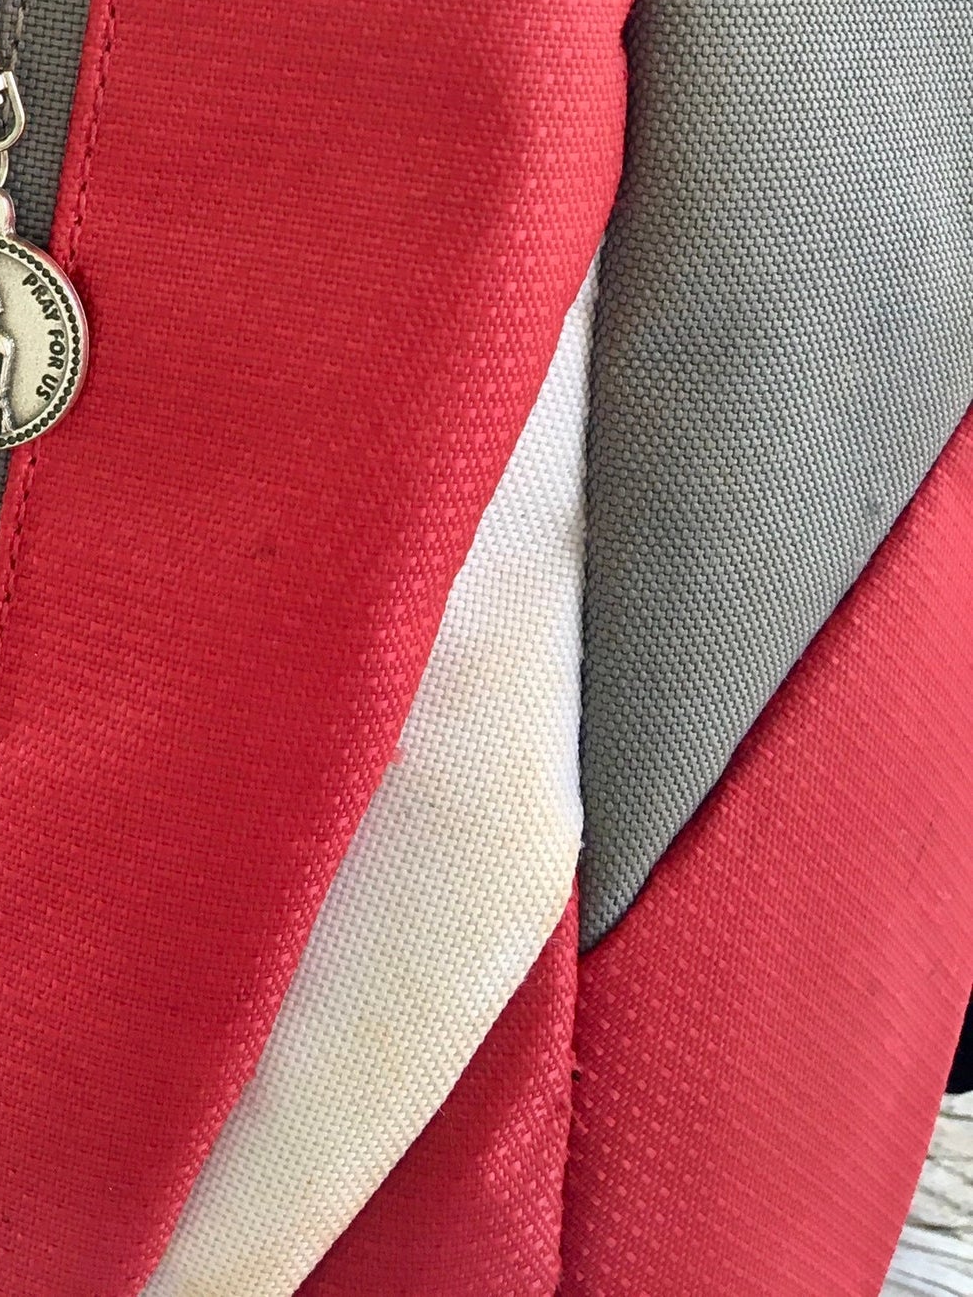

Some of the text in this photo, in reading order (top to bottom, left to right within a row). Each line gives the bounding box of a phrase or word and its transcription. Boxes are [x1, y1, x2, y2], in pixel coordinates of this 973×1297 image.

[22, 272, 66, 402] PRAY FOR US
